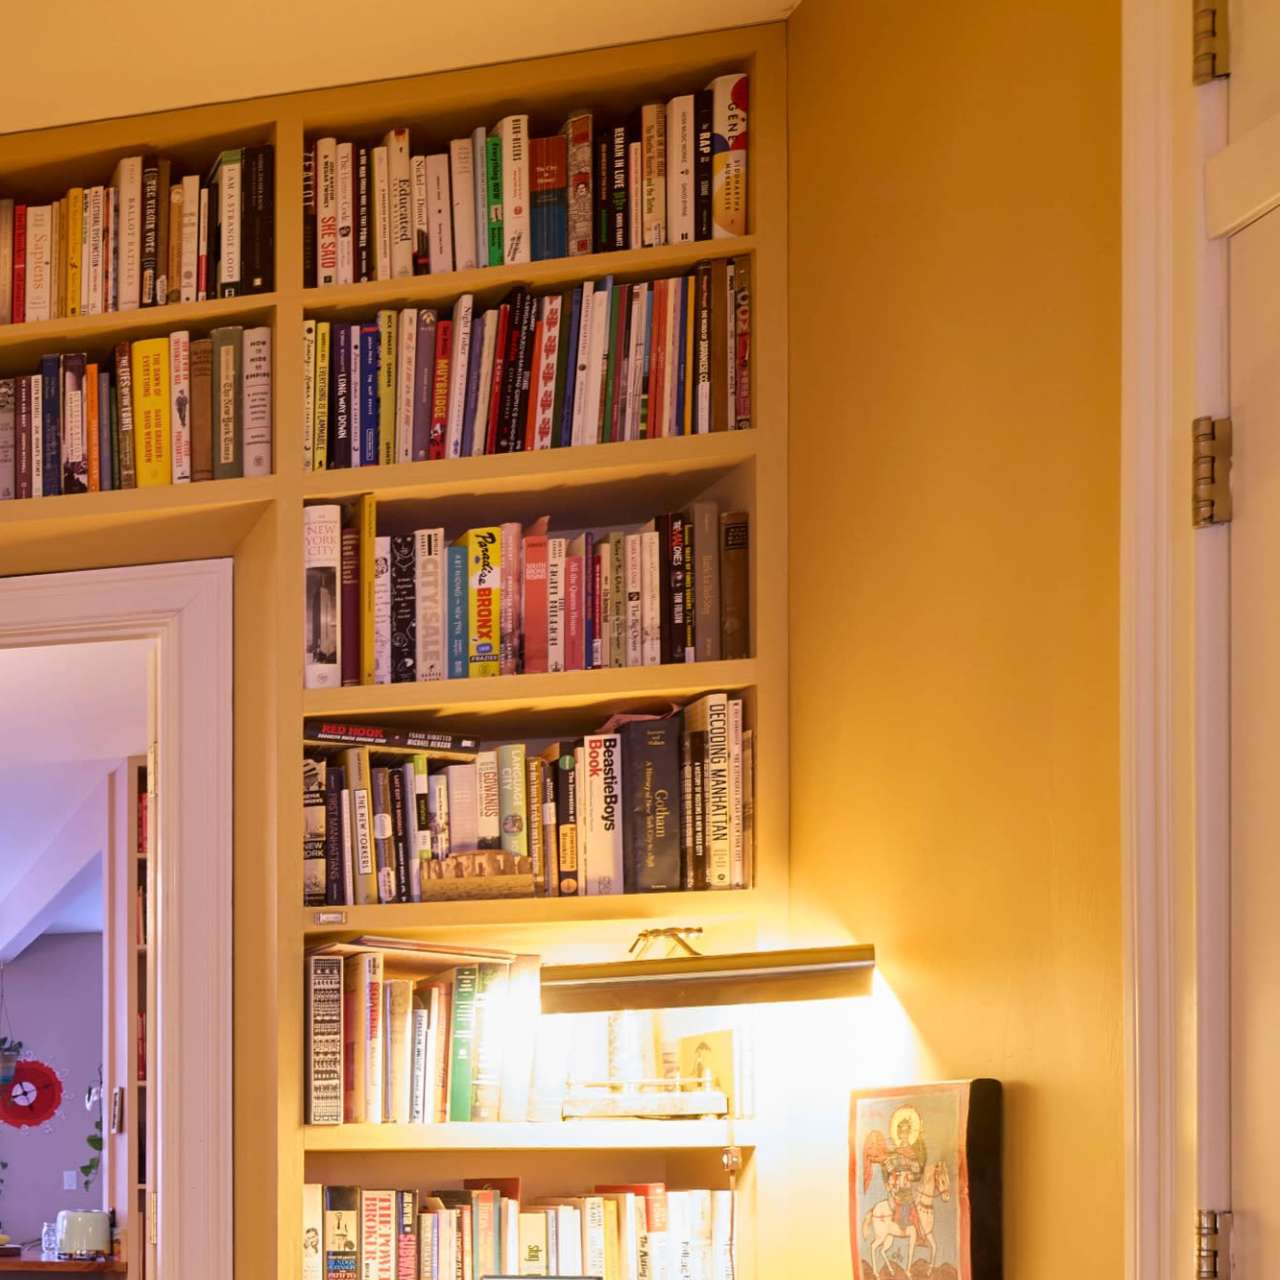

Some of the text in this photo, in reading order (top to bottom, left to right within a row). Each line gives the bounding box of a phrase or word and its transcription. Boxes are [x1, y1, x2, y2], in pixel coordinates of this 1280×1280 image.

[340, 153, 349, 170] The
[491, 142, 500, 181] Everything
[614, 127, 624, 189] REMAIN IN LOVE
[699, 132, 710, 154] RAP
[227, 175, 234, 189] AM
[304, 150, 314, 207] ZEALOT
[416, 160, 425, 186] Nickel
[145, 179, 155, 253] THE VIRGIN VOTE
[399, 179, 410, 242] Educated
[417, 199, 425, 225] Dimed
[127, 198, 135, 286] BALLOT BATTLES
[321, 216, 336, 269] SHE SAID
[359, 228, 367, 247] POWER
[31, 234, 47, 289] Sapiens
[461, 331, 470, 355] Fisher
[143, 356, 151, 397] EVERYTHING
[434, 359, 449, 419] MUYBRIDGE
[120, 368, 132, 431] LIES LAND
[317, 366, 327, 450] EVERYTHING FLAMMABLE
[338, 373, 348, 439] LONG WAY DOWN
[222, 382, 233, 461] The New York Times
[305, 535, 338, 547] YORK
[307, 525, 337, 536] NEW
[308, 546, 335, 557] CITY
[673, 547, 682, 566] ONES
[421, 559, 439, 603] CITY
[472, 532, 496, 643] Paradise BRONX,
[570, 573, 578, 584] the
[422, 613, 440, 662] SALE
[630, 618, 639, 630] Big
[321, 723, 384, 738] RED HOOK
[502, 768, 512, 790] CITY
[512, 750, 521, 806] LANGUAGE
[588, 739, 602, 777] Book
[710, 705, 727, 841] DECODING MANHATTAN
[358, 795, 366, 809] THE
[484, 771, 497, 817] GOWANUS
[655, 789, 669, 838] Gotham
[330, 818, 339, 880] MANHATTANS
[360, 833, 368, 869] YORKERS
[364, 1196, 377, 1260] BROKER
[378, 1194, 391, 1230] THE
